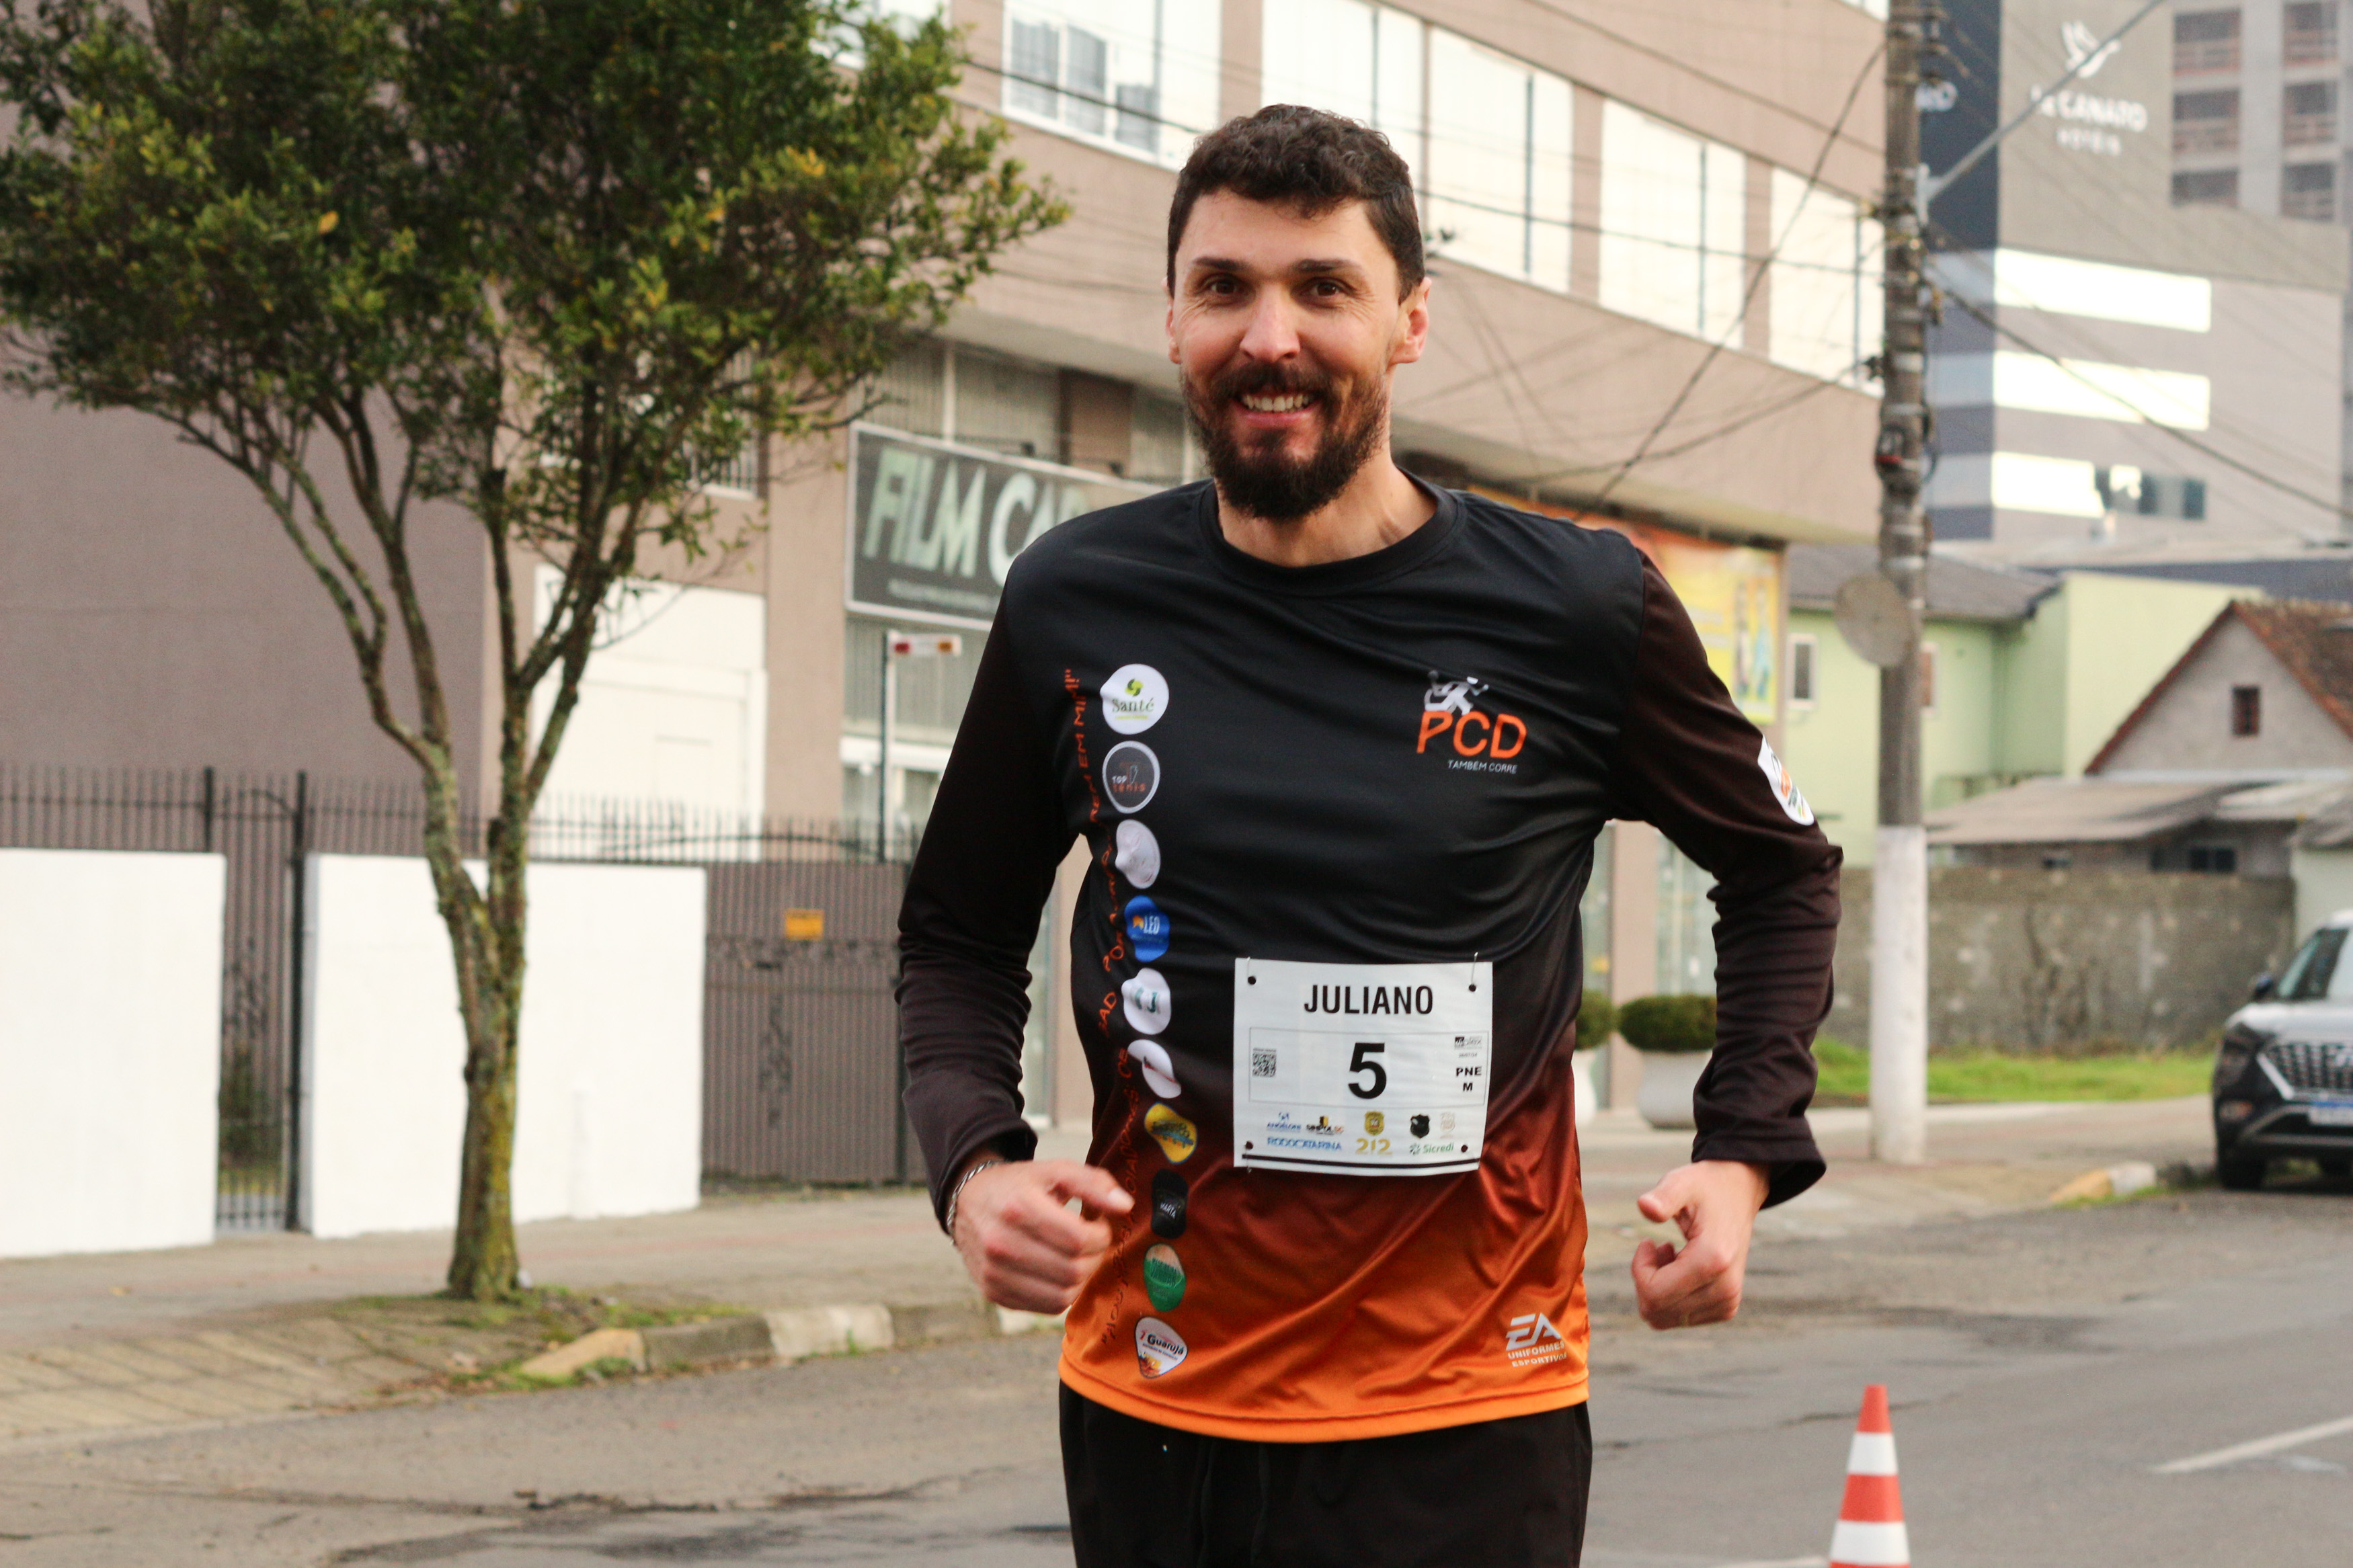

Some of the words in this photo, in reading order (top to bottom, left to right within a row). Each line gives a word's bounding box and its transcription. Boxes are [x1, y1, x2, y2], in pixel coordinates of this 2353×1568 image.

[863, 446, 987, 579] FILM
[1112, 697, 1155, 712] Santé
[1416, 710, 1527, 759] PCD
[1488, 762, 1518, 775] CORRE
[1304, 984, 1433, 1016] JULIANO
[1348, 1042, 1388, 1100] 5
[1455, 1066, 1482, 1077] PNE
[1462, 1082, 1474, 1092] M
[1423, 1143, 1454, 1154] Sicredi
[1507, 1340, 1566, 1360] UNIFORMES
[1511, 1352, 1568, 1368] ESPORTIVOS
